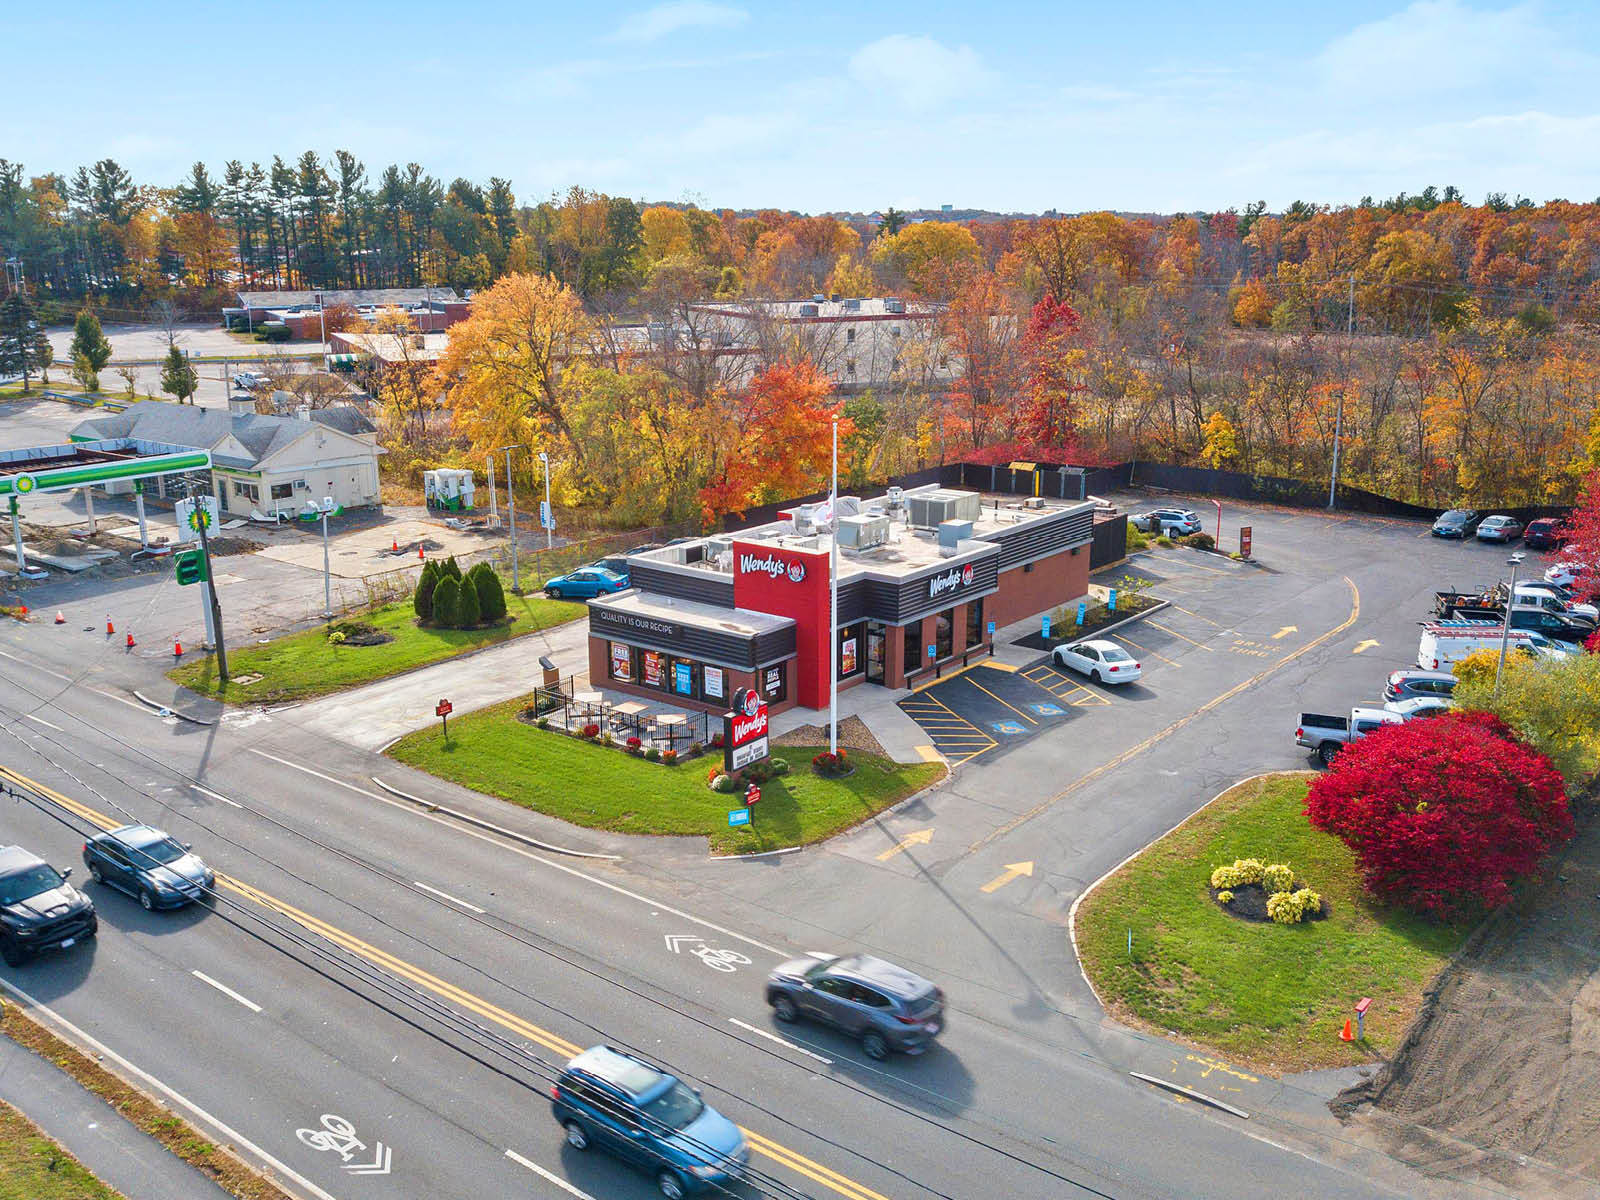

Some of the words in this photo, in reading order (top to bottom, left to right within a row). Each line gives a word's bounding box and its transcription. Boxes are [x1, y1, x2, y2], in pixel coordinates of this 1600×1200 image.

[740, 553, 785, 578] Wendy's
[930, 569, 961, 597] Wendy's
[600, 611, 627, 624] QUALITY
[628, 617, 634, 626] IS
[635, 619, 649, 628] OUR
[650, 622, 673, 634] RECIPE
[734, 712, 767, 742] Wendy's
